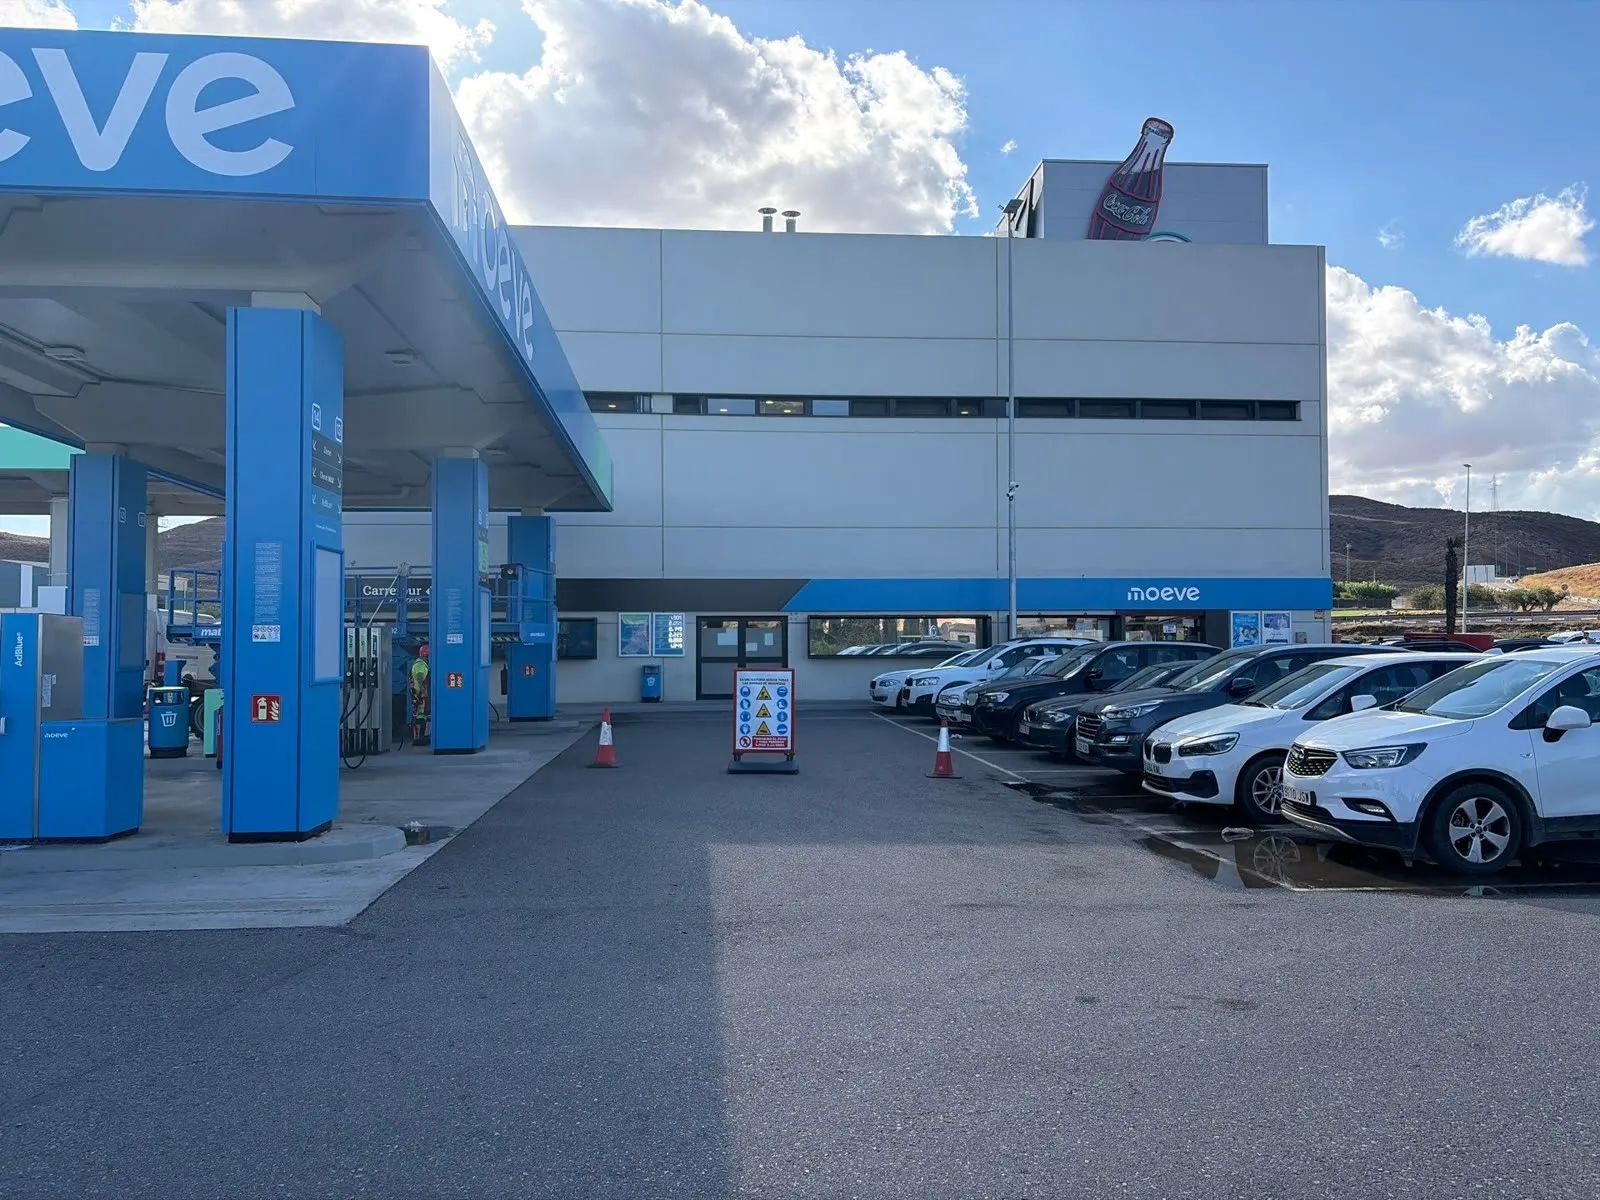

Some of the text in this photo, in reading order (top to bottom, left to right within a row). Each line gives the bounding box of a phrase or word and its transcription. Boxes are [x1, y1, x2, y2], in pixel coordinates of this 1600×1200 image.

[0, 47, 296, 178] ve
[452, 130, 534, 361] moeve
[362, 585, 422, 596] Carreur
[1127, 586, 1200, 601] moeve
